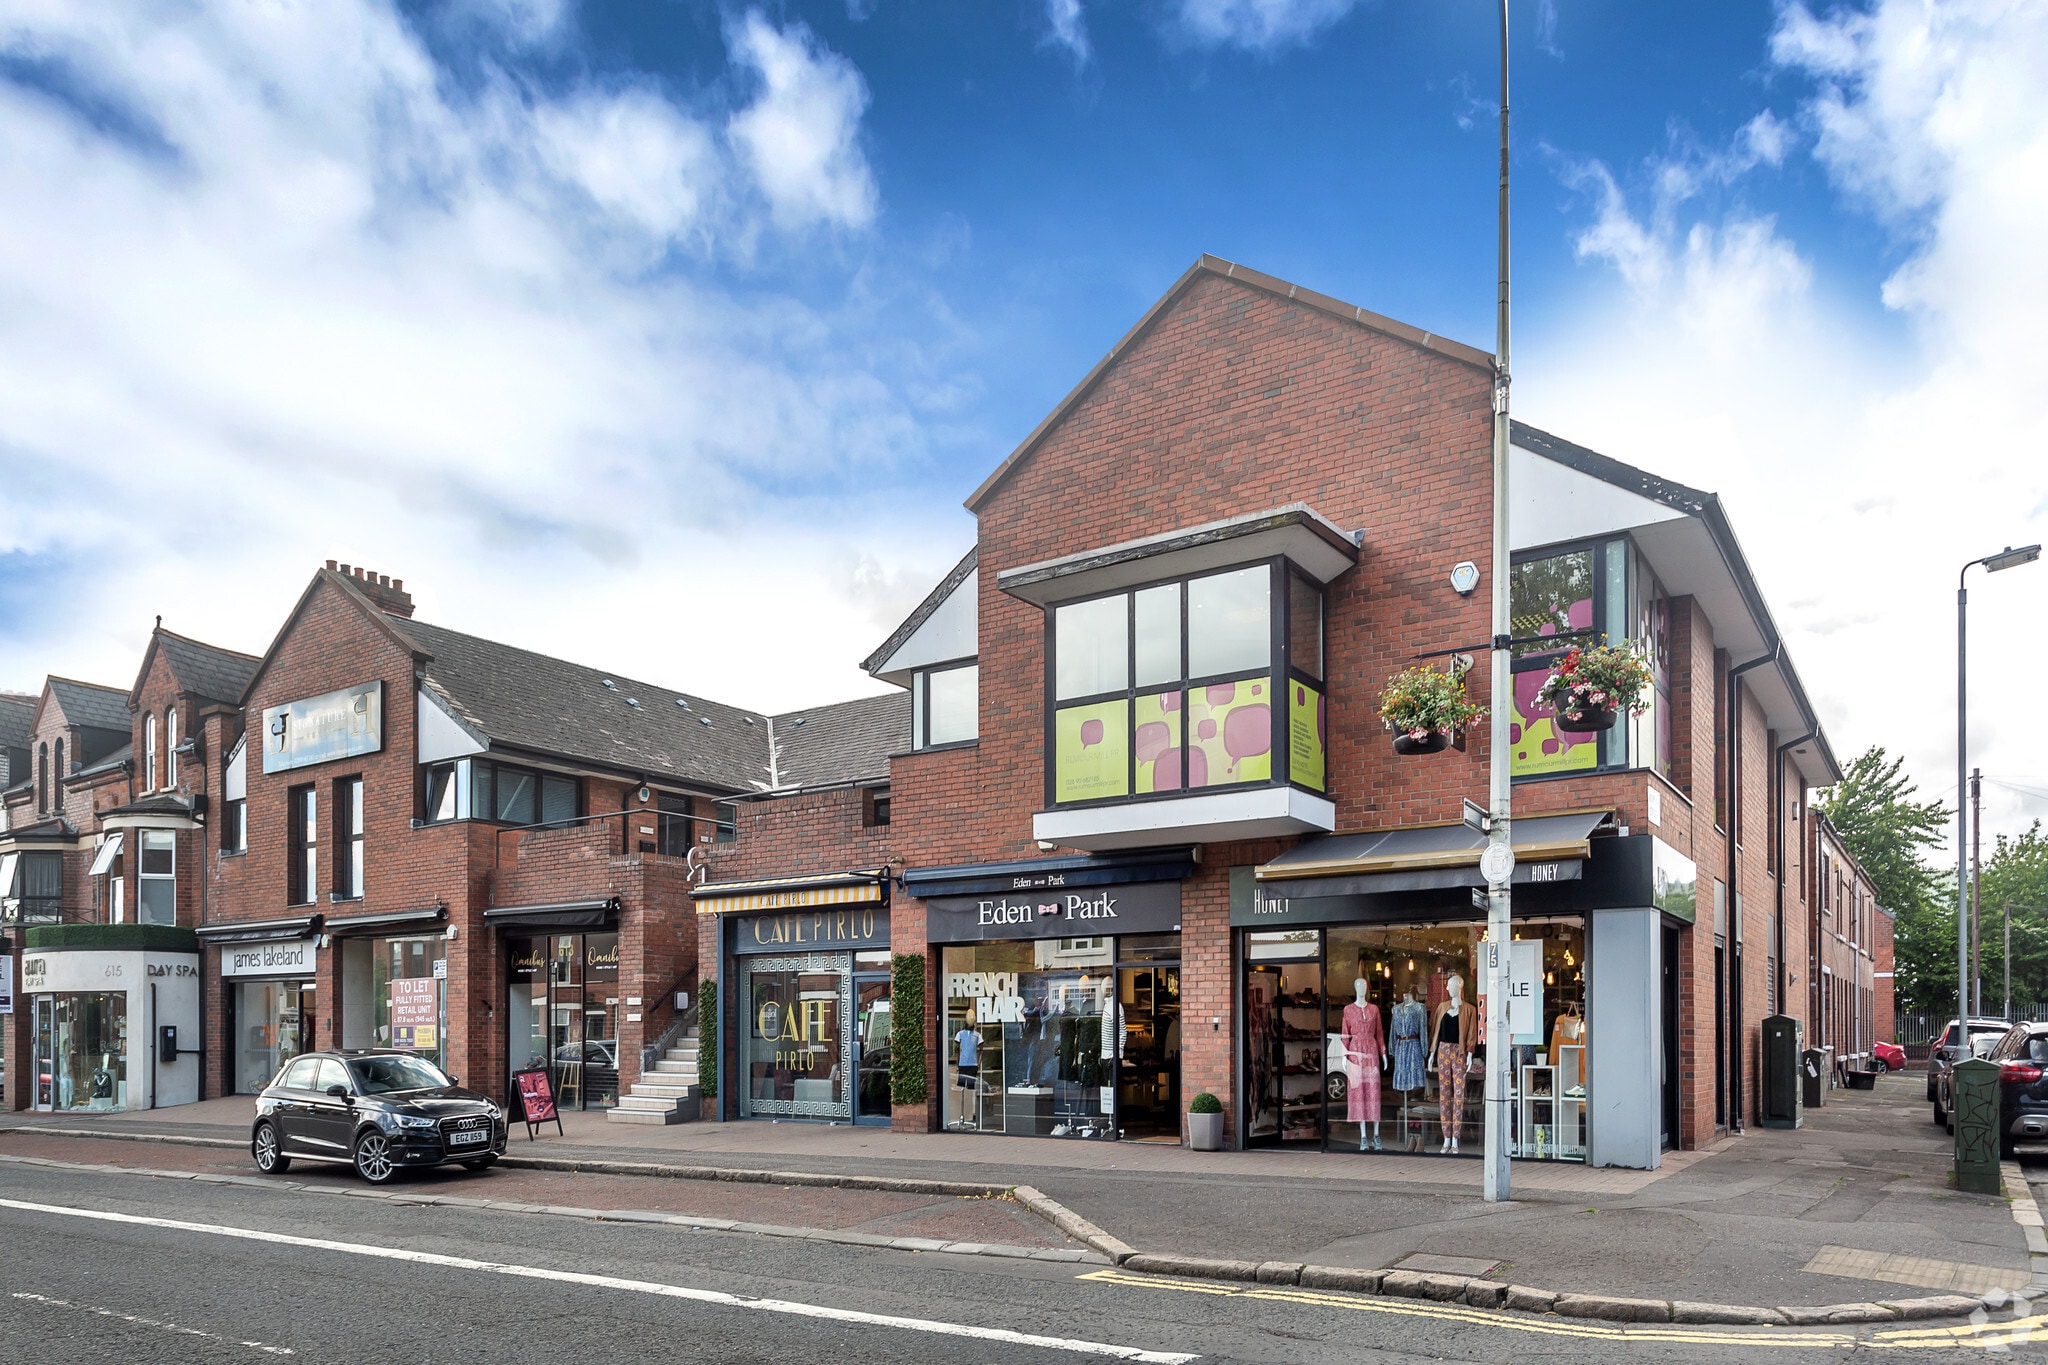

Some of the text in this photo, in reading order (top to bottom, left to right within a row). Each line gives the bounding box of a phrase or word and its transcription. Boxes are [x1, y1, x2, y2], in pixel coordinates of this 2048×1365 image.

[1013, 874, 1065, 889] Eden Park
[1531, 863, 1559, 882] HONEY
[977, 891, 1119, 926] Eden Park
[813, 908, 874, 942] PIRLO
[233, 943, 304, 974] james lakeland
[511, 949, 546, 969] Omnibus
[104, 964, 123, 977] 615
[147, 964, 198, 978] DAY SPA
[399, 980, 429, 994] TO LET
[947, 972, 1018, 997] FRENCH
[1510, 982, 1530, 997] LE
[395, 994, 433, 1005] FULLY FITTED
[397, 1005, 431, 1015] RETAIL UNIT
[976, 996, 1027, 1023] FLAIR
[758, 1000, 833, 1042] CAFE
[775, 1050, 815, 1072] PIRLO
[455, 1132, 470, 1143] EGZ
